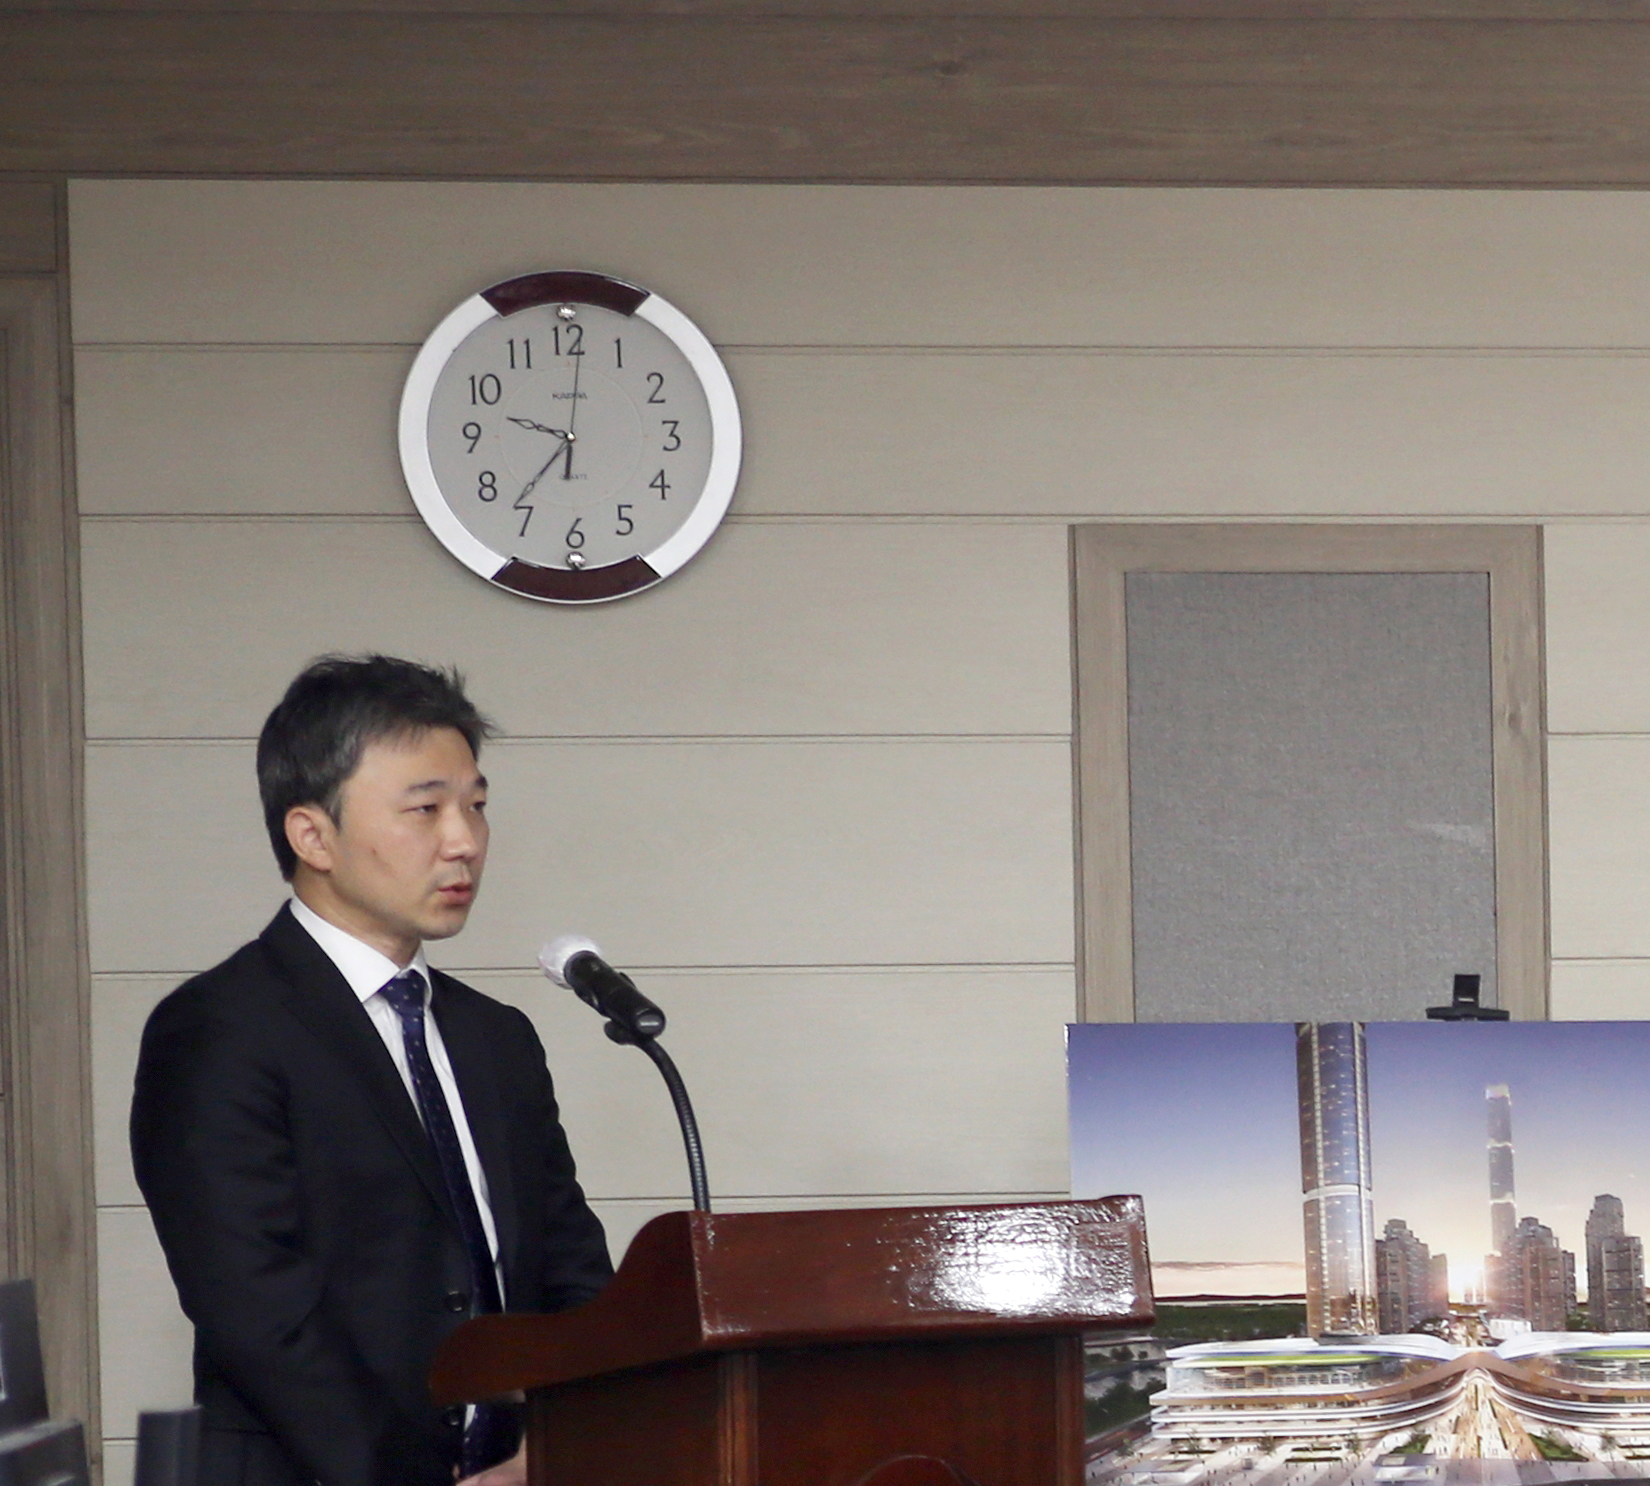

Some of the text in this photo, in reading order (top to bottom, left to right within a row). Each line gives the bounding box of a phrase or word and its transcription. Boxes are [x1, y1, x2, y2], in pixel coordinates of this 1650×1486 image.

[507, 338, 532, 369] 11
[552, 324, 586, 356] 12
[614, 338, 623, 368] 1
[468, 373, 501, 405] 10
[646, 372, 666, 404] 2
[462, 422, 482, 453] 9
[661, 420, 682, 451] 3
[477, 470, 498, 502] 8
[648, 469, 671, 500] 4
[513, 506, 534, 537] 7
[565, 517, 585, 549] 6
[615, 504, 634, 535] 5
